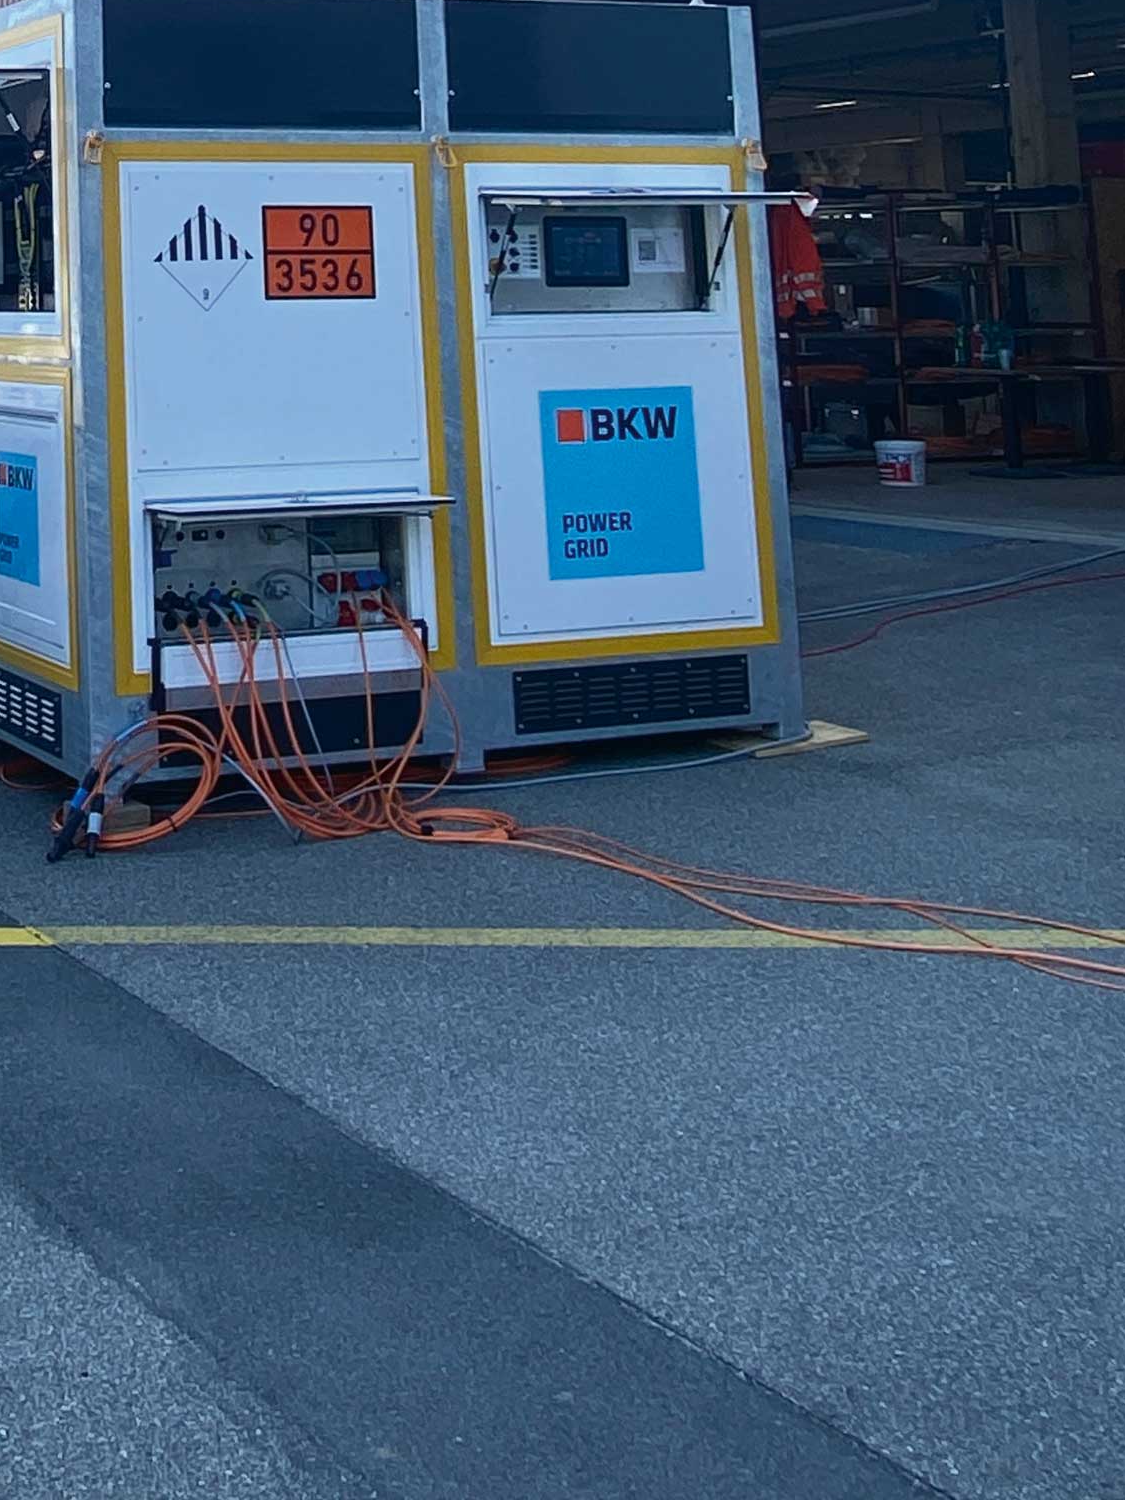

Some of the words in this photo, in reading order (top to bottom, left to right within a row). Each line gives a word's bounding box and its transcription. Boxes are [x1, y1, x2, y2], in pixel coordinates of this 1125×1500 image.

[299, 213, 339, 247] 90
[275, 258, 363, 292] 3536
[590, 405, 677, 442] BKW
[8, 465, 33, 491] BKW
[562, 511, 633, 534] POWER
[564, 538, 609, 560] GRID
